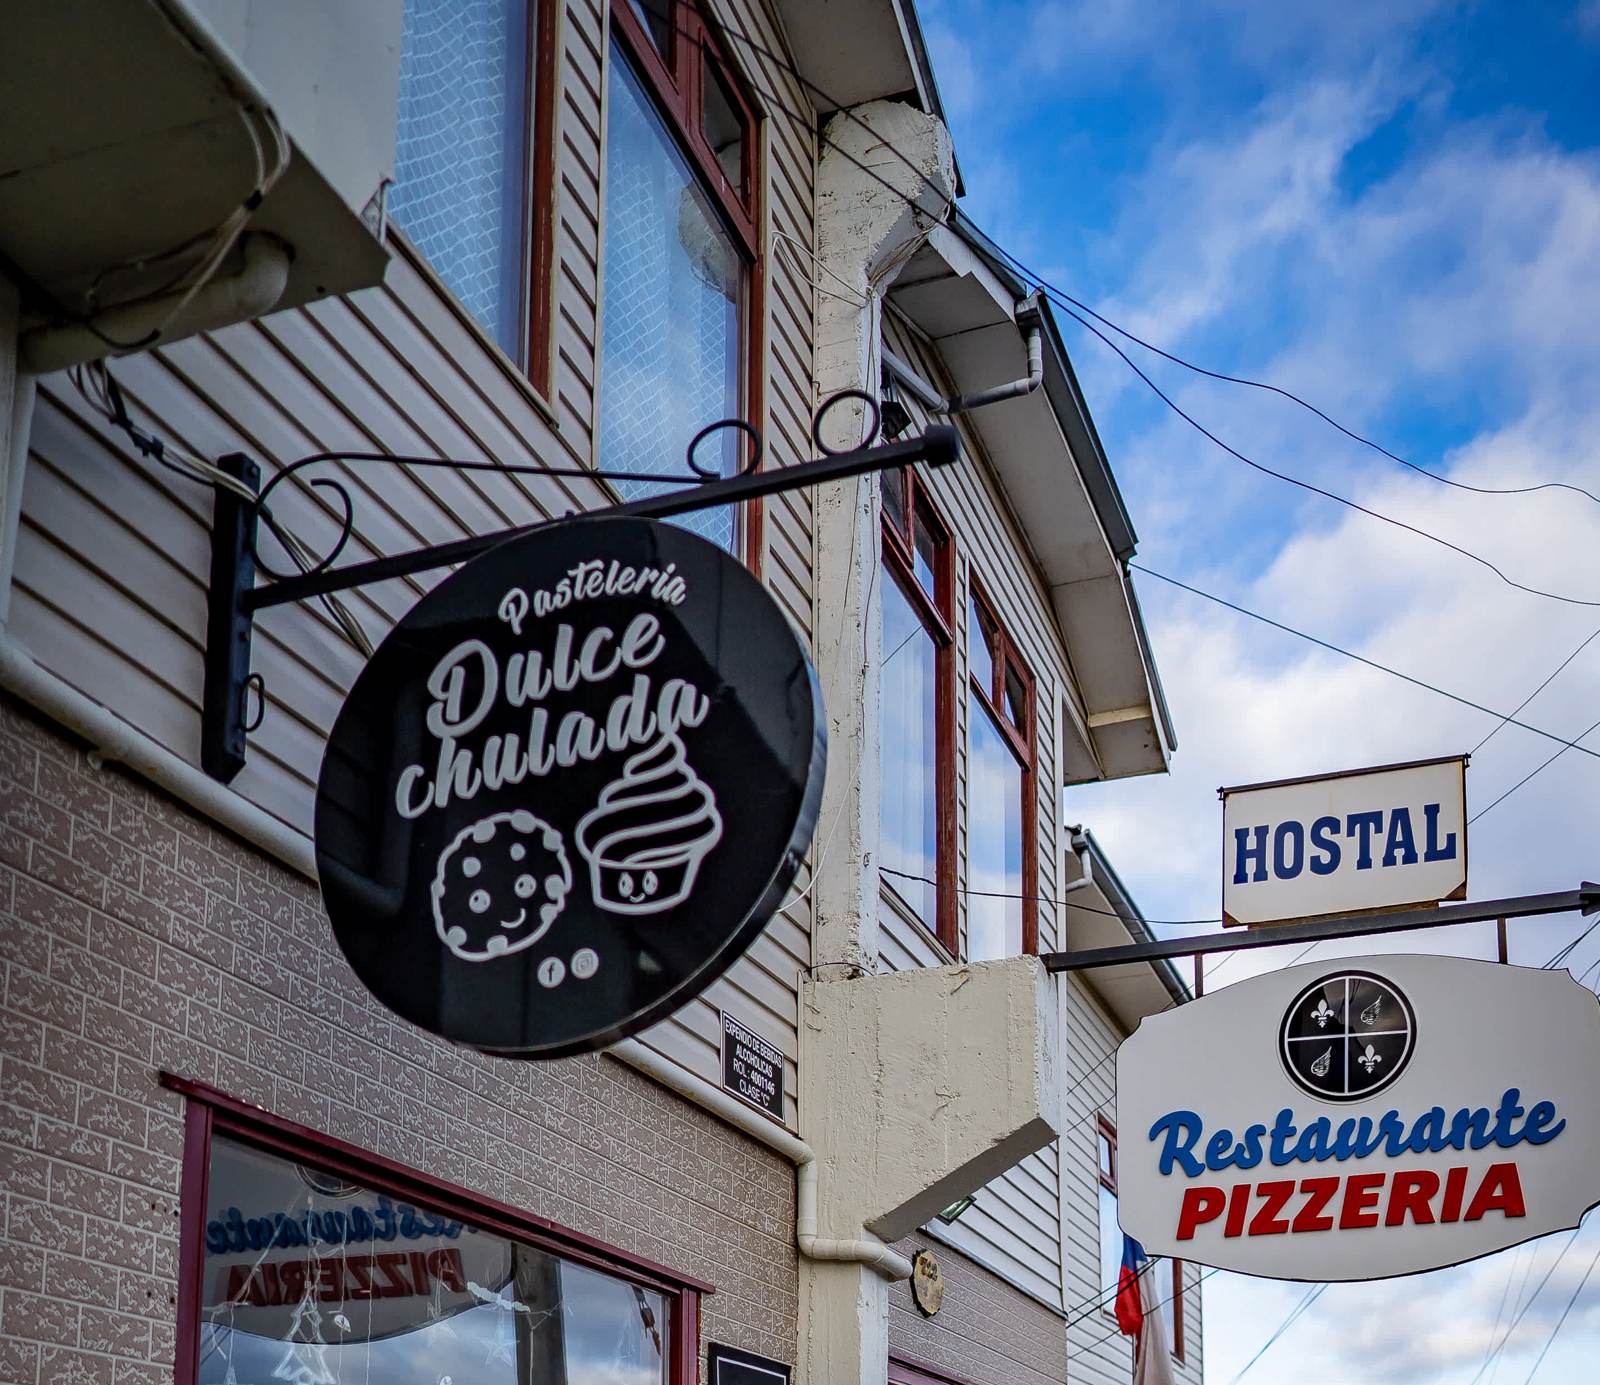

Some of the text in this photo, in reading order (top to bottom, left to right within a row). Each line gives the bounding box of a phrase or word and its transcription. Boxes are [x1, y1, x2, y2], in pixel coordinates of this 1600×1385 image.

[498, 559, 686, 636] Pasteleria
[427, 613, 665, 739] Dulce
[1232, 803, 1457, 885] HOSTAL
[725, 1020, 782, 1068] EXPENDIO DE BEBIDAS
[739, 1079, 761, 1102] CLASE
[1149, 1088, 1566, 1178] Restaurante
[1175, 1162, 1527, 1241] PIZZERIA
